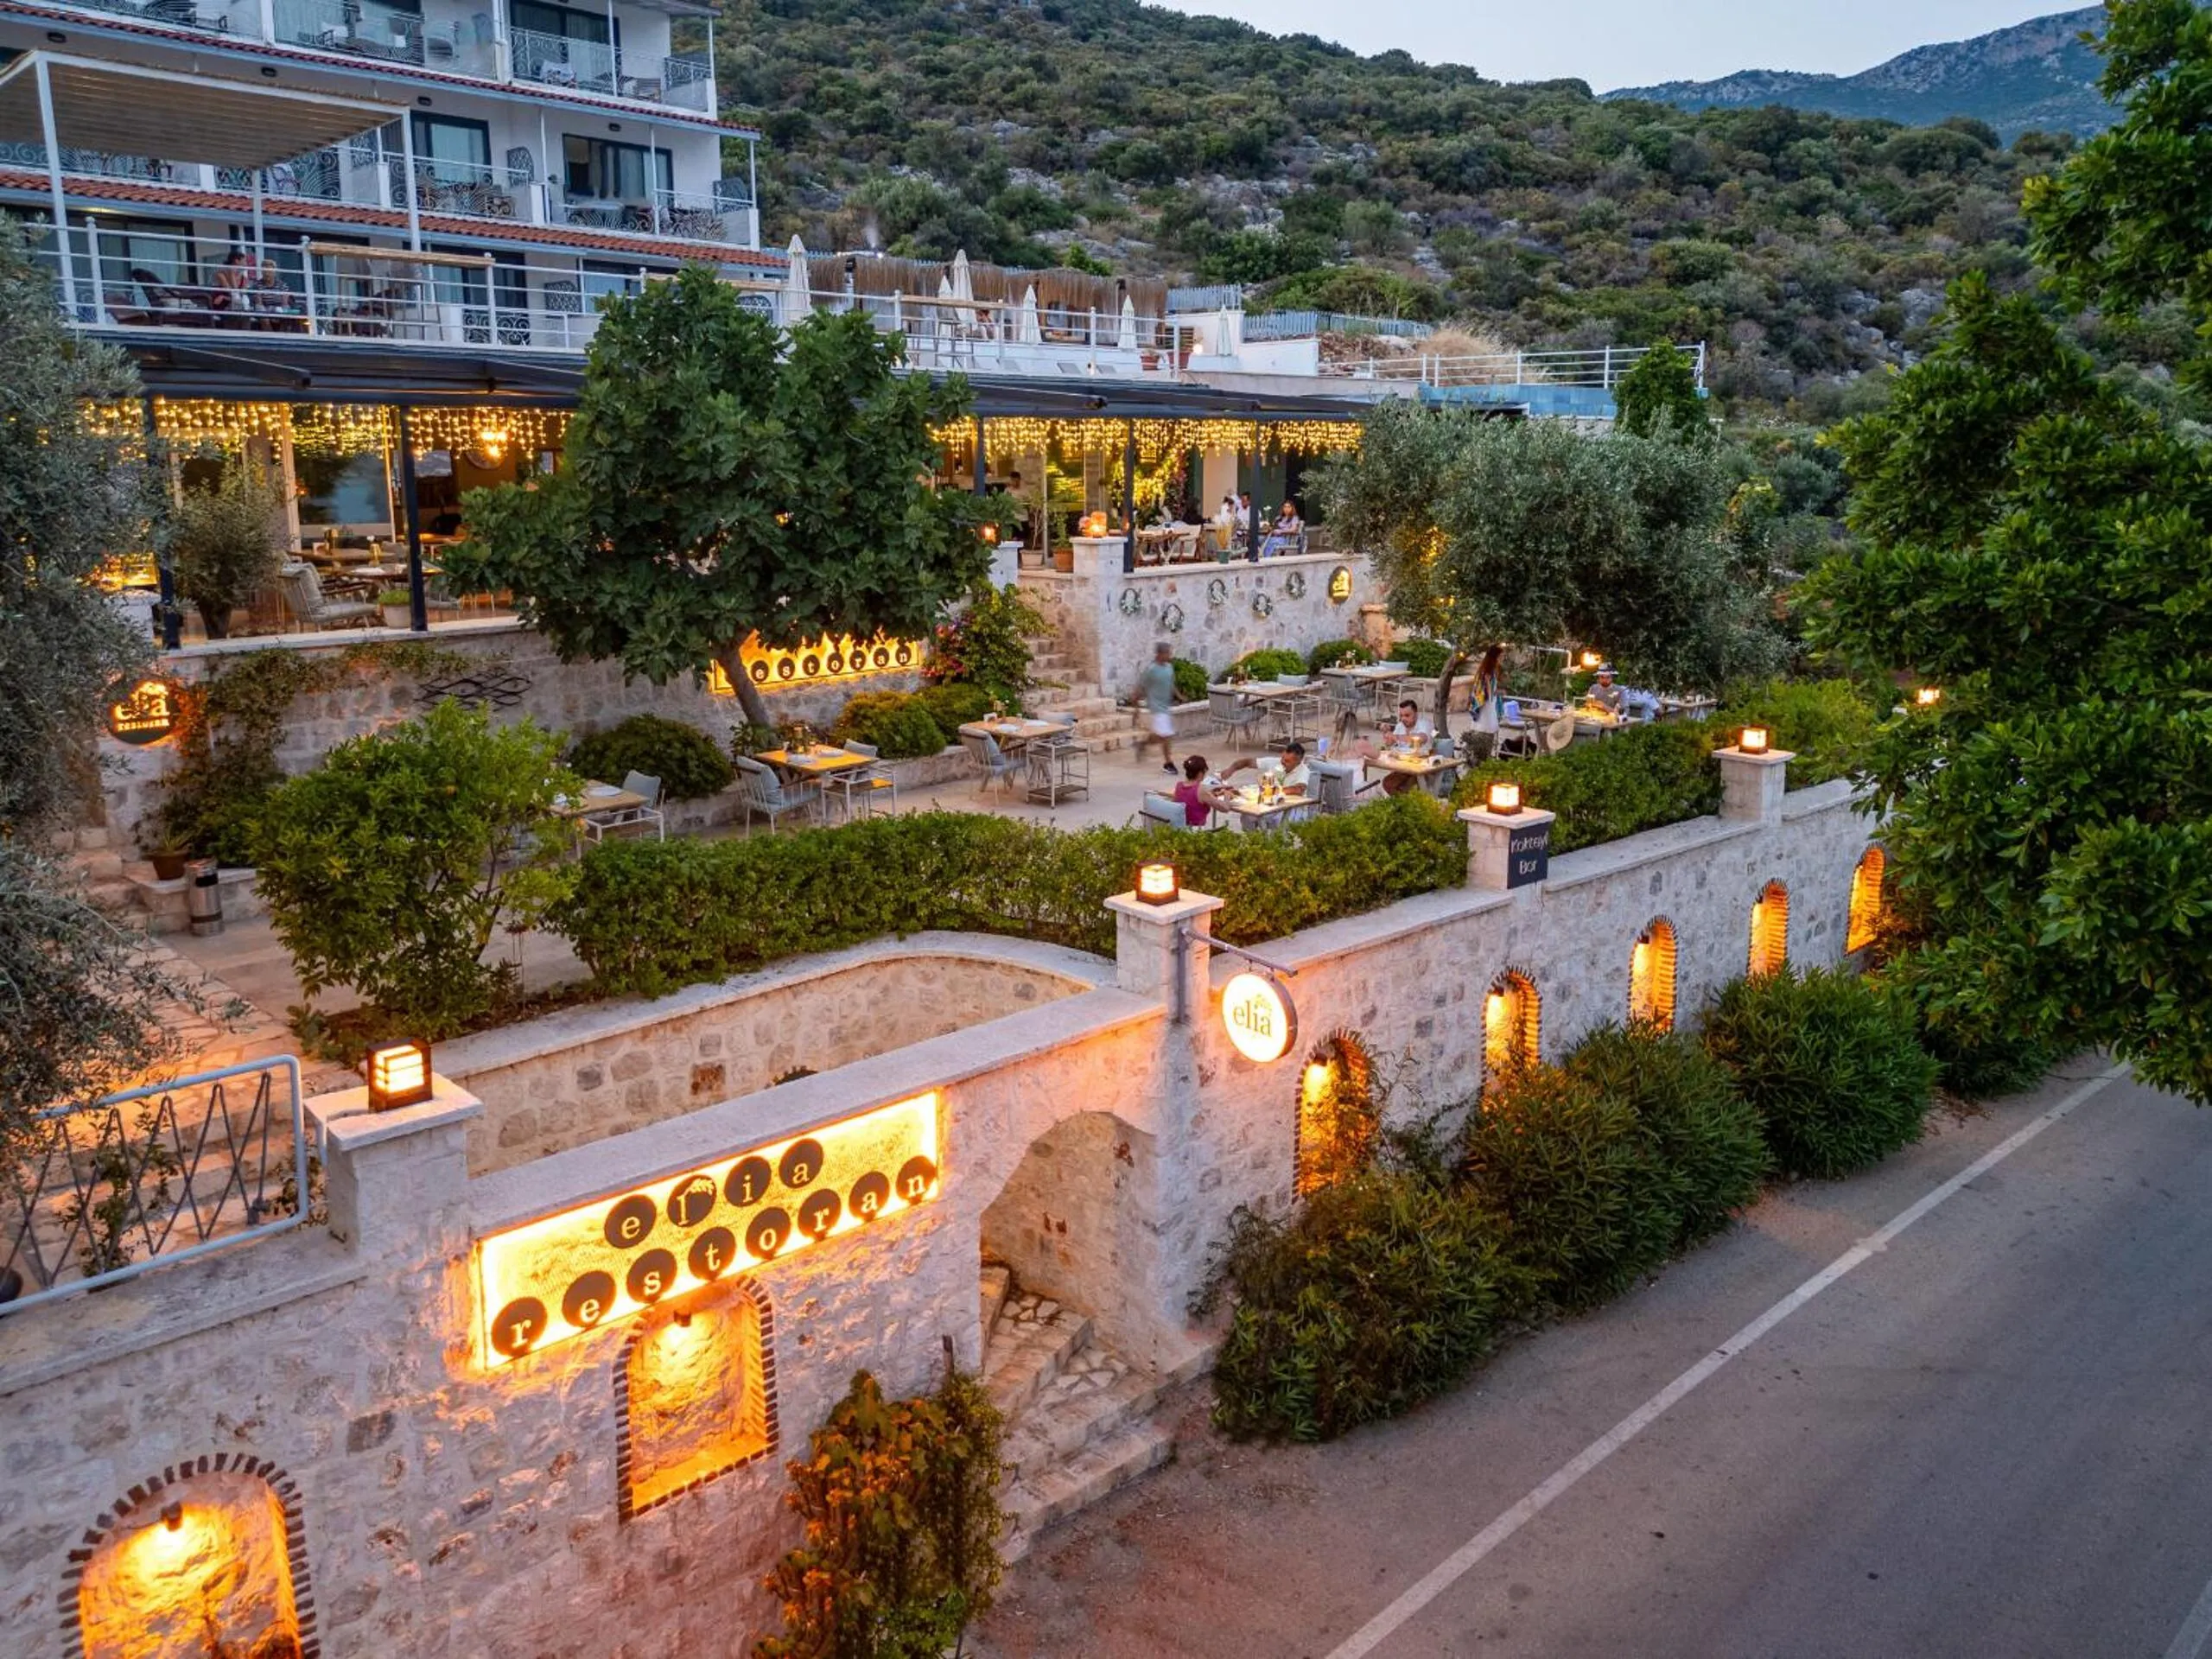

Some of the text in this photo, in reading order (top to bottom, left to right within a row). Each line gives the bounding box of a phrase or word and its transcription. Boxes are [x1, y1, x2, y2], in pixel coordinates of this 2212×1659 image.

[753, 650, 909, 679] estoran
[1233, 1000, 1273, 1038] elia
[620, 1160, 811, 1239] elia
[510, 1173, 932, 1348] restoran
